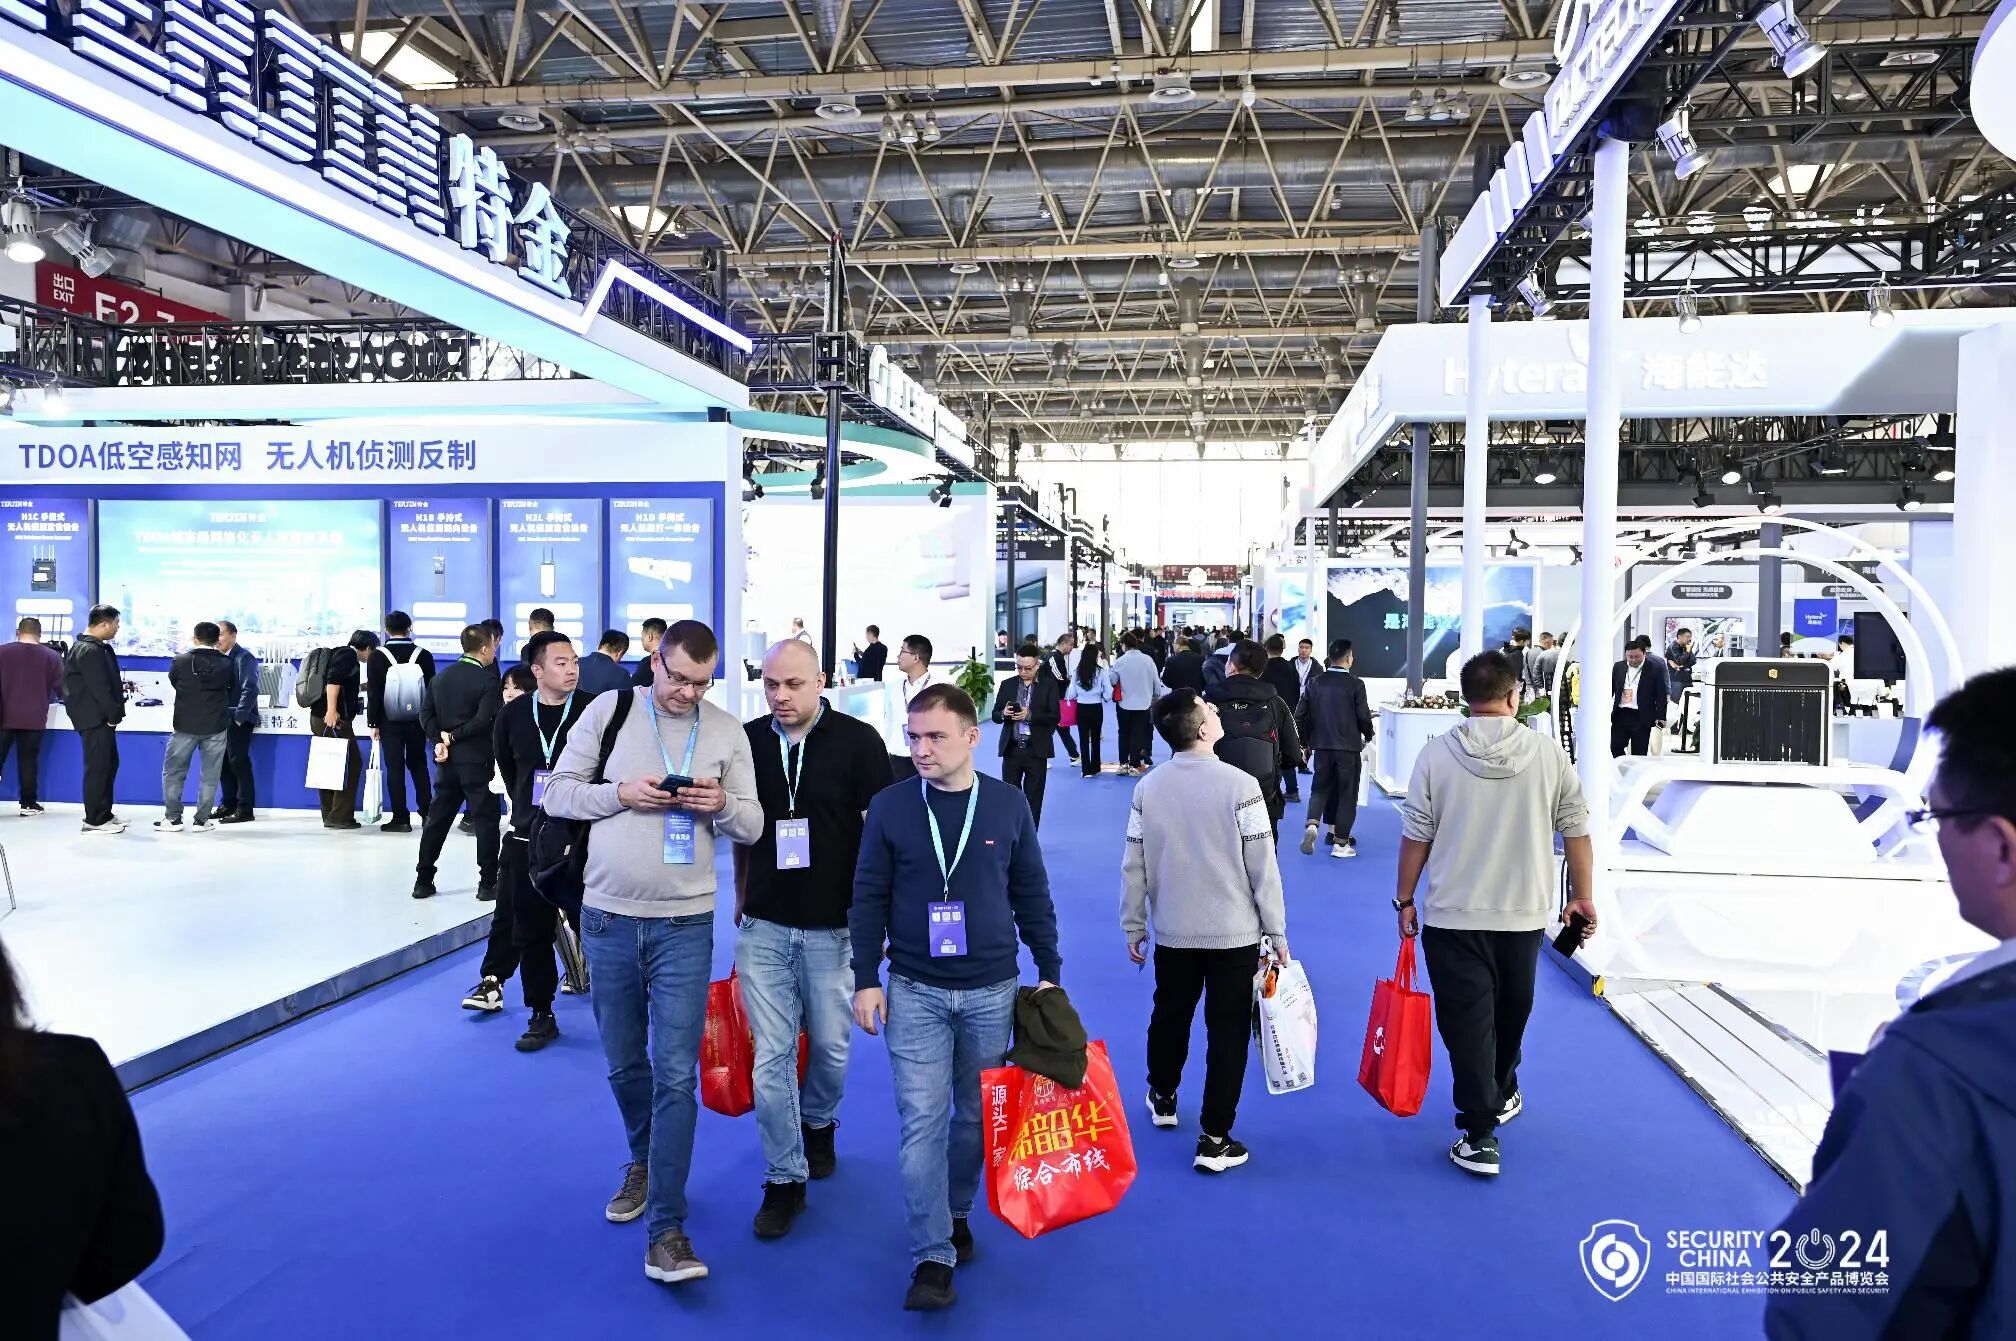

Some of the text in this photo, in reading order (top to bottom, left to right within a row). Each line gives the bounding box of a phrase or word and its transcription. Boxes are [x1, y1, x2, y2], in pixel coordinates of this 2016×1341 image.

[53, 273, 75, 292] 出口
[53, 289, 75, 304] EXIT
[1641, 351, 1769, 391] 海能达
[18, 440, 477, 471] TDOA低空感知网 无人机侦测反制
[271, 715, 298, 729] 特金
[1013, 1146, 1111, 1193] 综合布线
